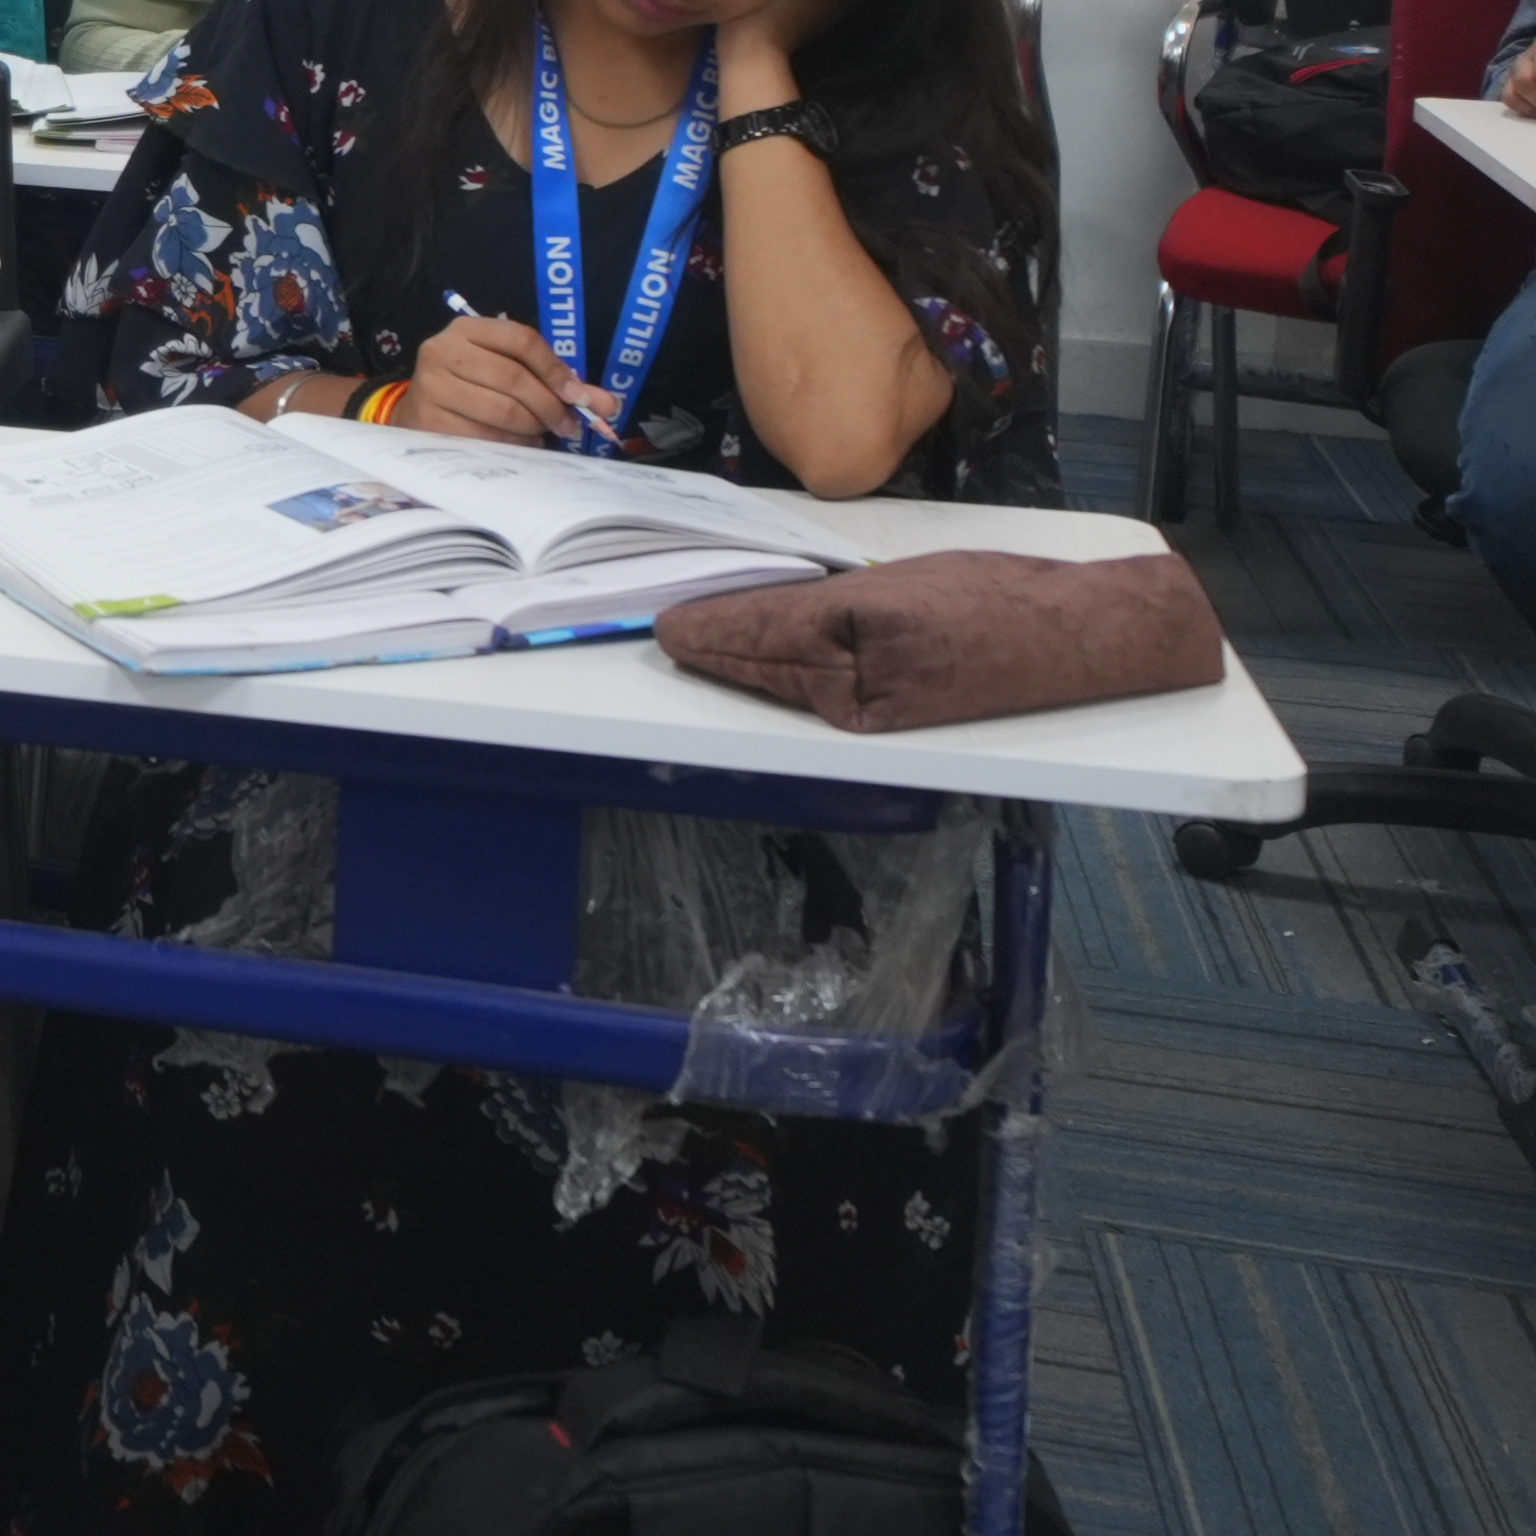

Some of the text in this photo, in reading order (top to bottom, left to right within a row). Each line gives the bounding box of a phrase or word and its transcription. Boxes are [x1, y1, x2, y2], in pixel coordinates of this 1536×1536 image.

[539, 71, 567, 171] MAGIC
[672, 91, 719, 190] MAGIC
[546, 236, 576, 357] BILLION
[619, 248, 676, 367] BILLION
